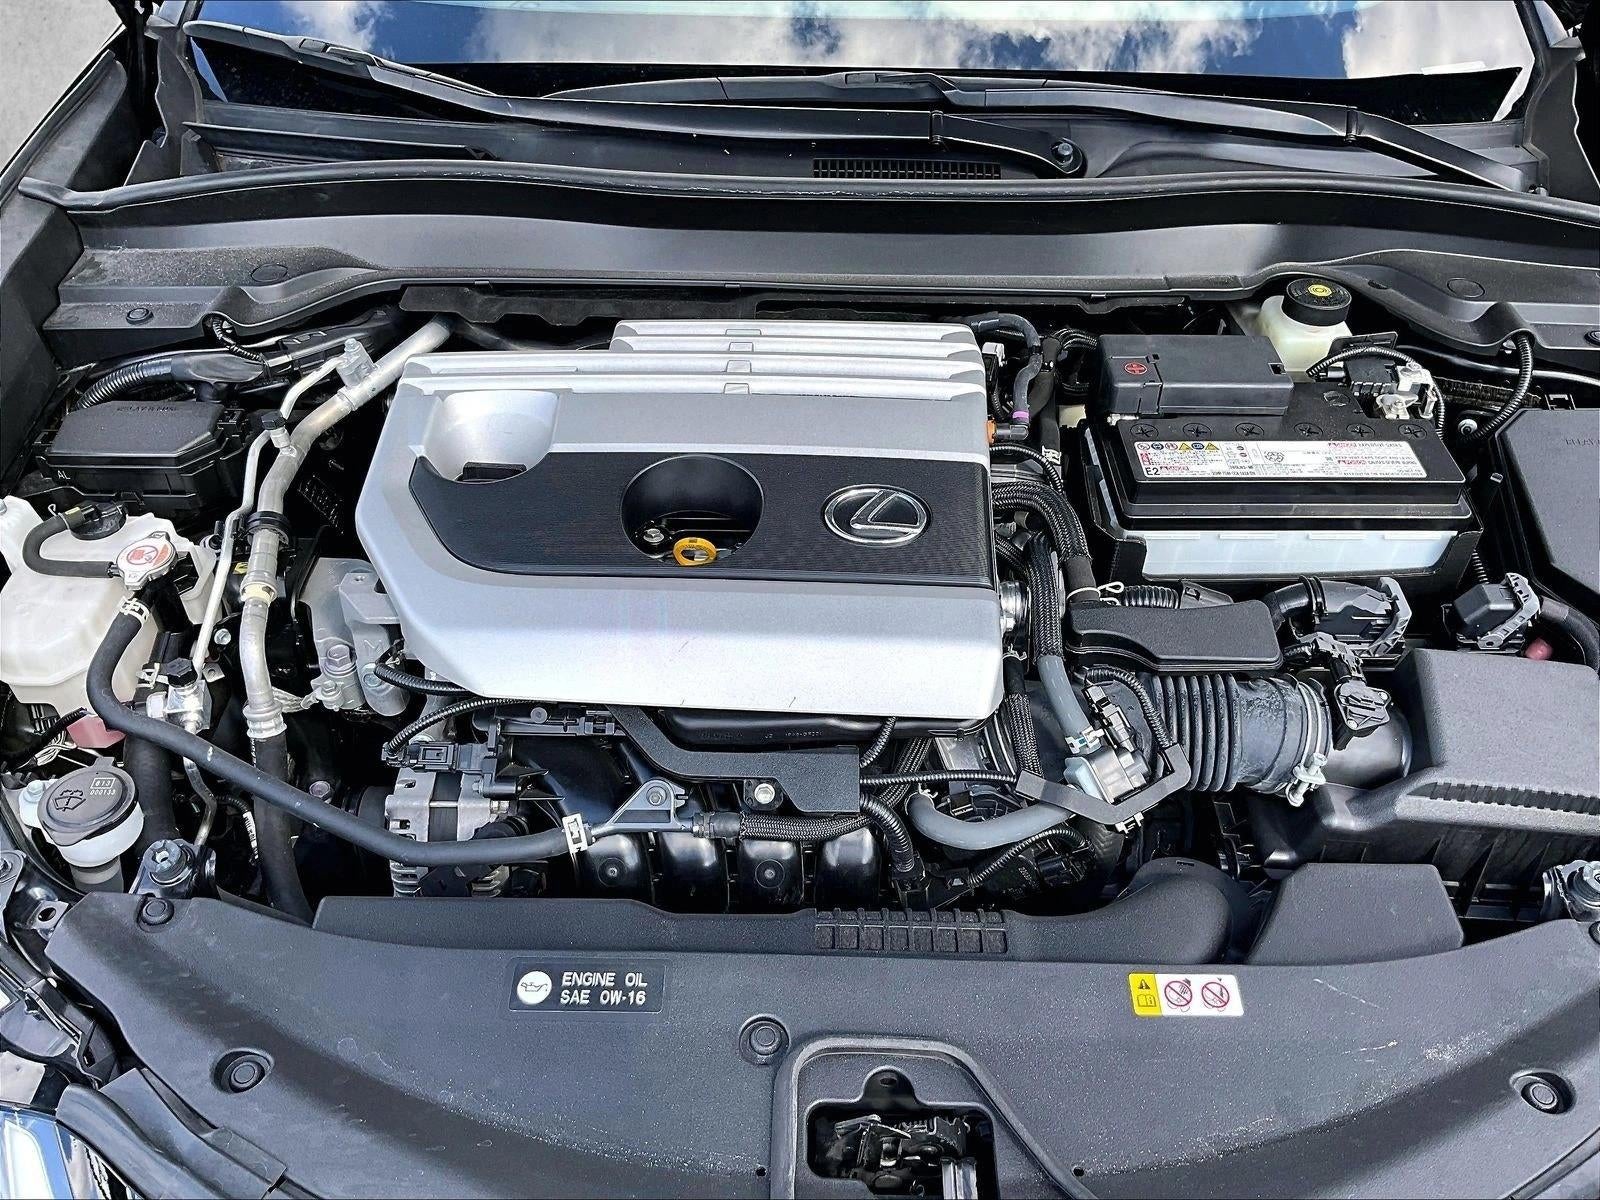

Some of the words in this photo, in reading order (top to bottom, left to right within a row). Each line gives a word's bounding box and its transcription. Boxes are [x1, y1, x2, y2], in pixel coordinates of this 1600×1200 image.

[1145, 467, 1160, 476] E2
[561, 971, 616, 987] ENGINE
[624, 972, 648, 987] OIL
[559, 989, 591, 1005] SAE
[599, 989, 646, 1006] 0W-16
